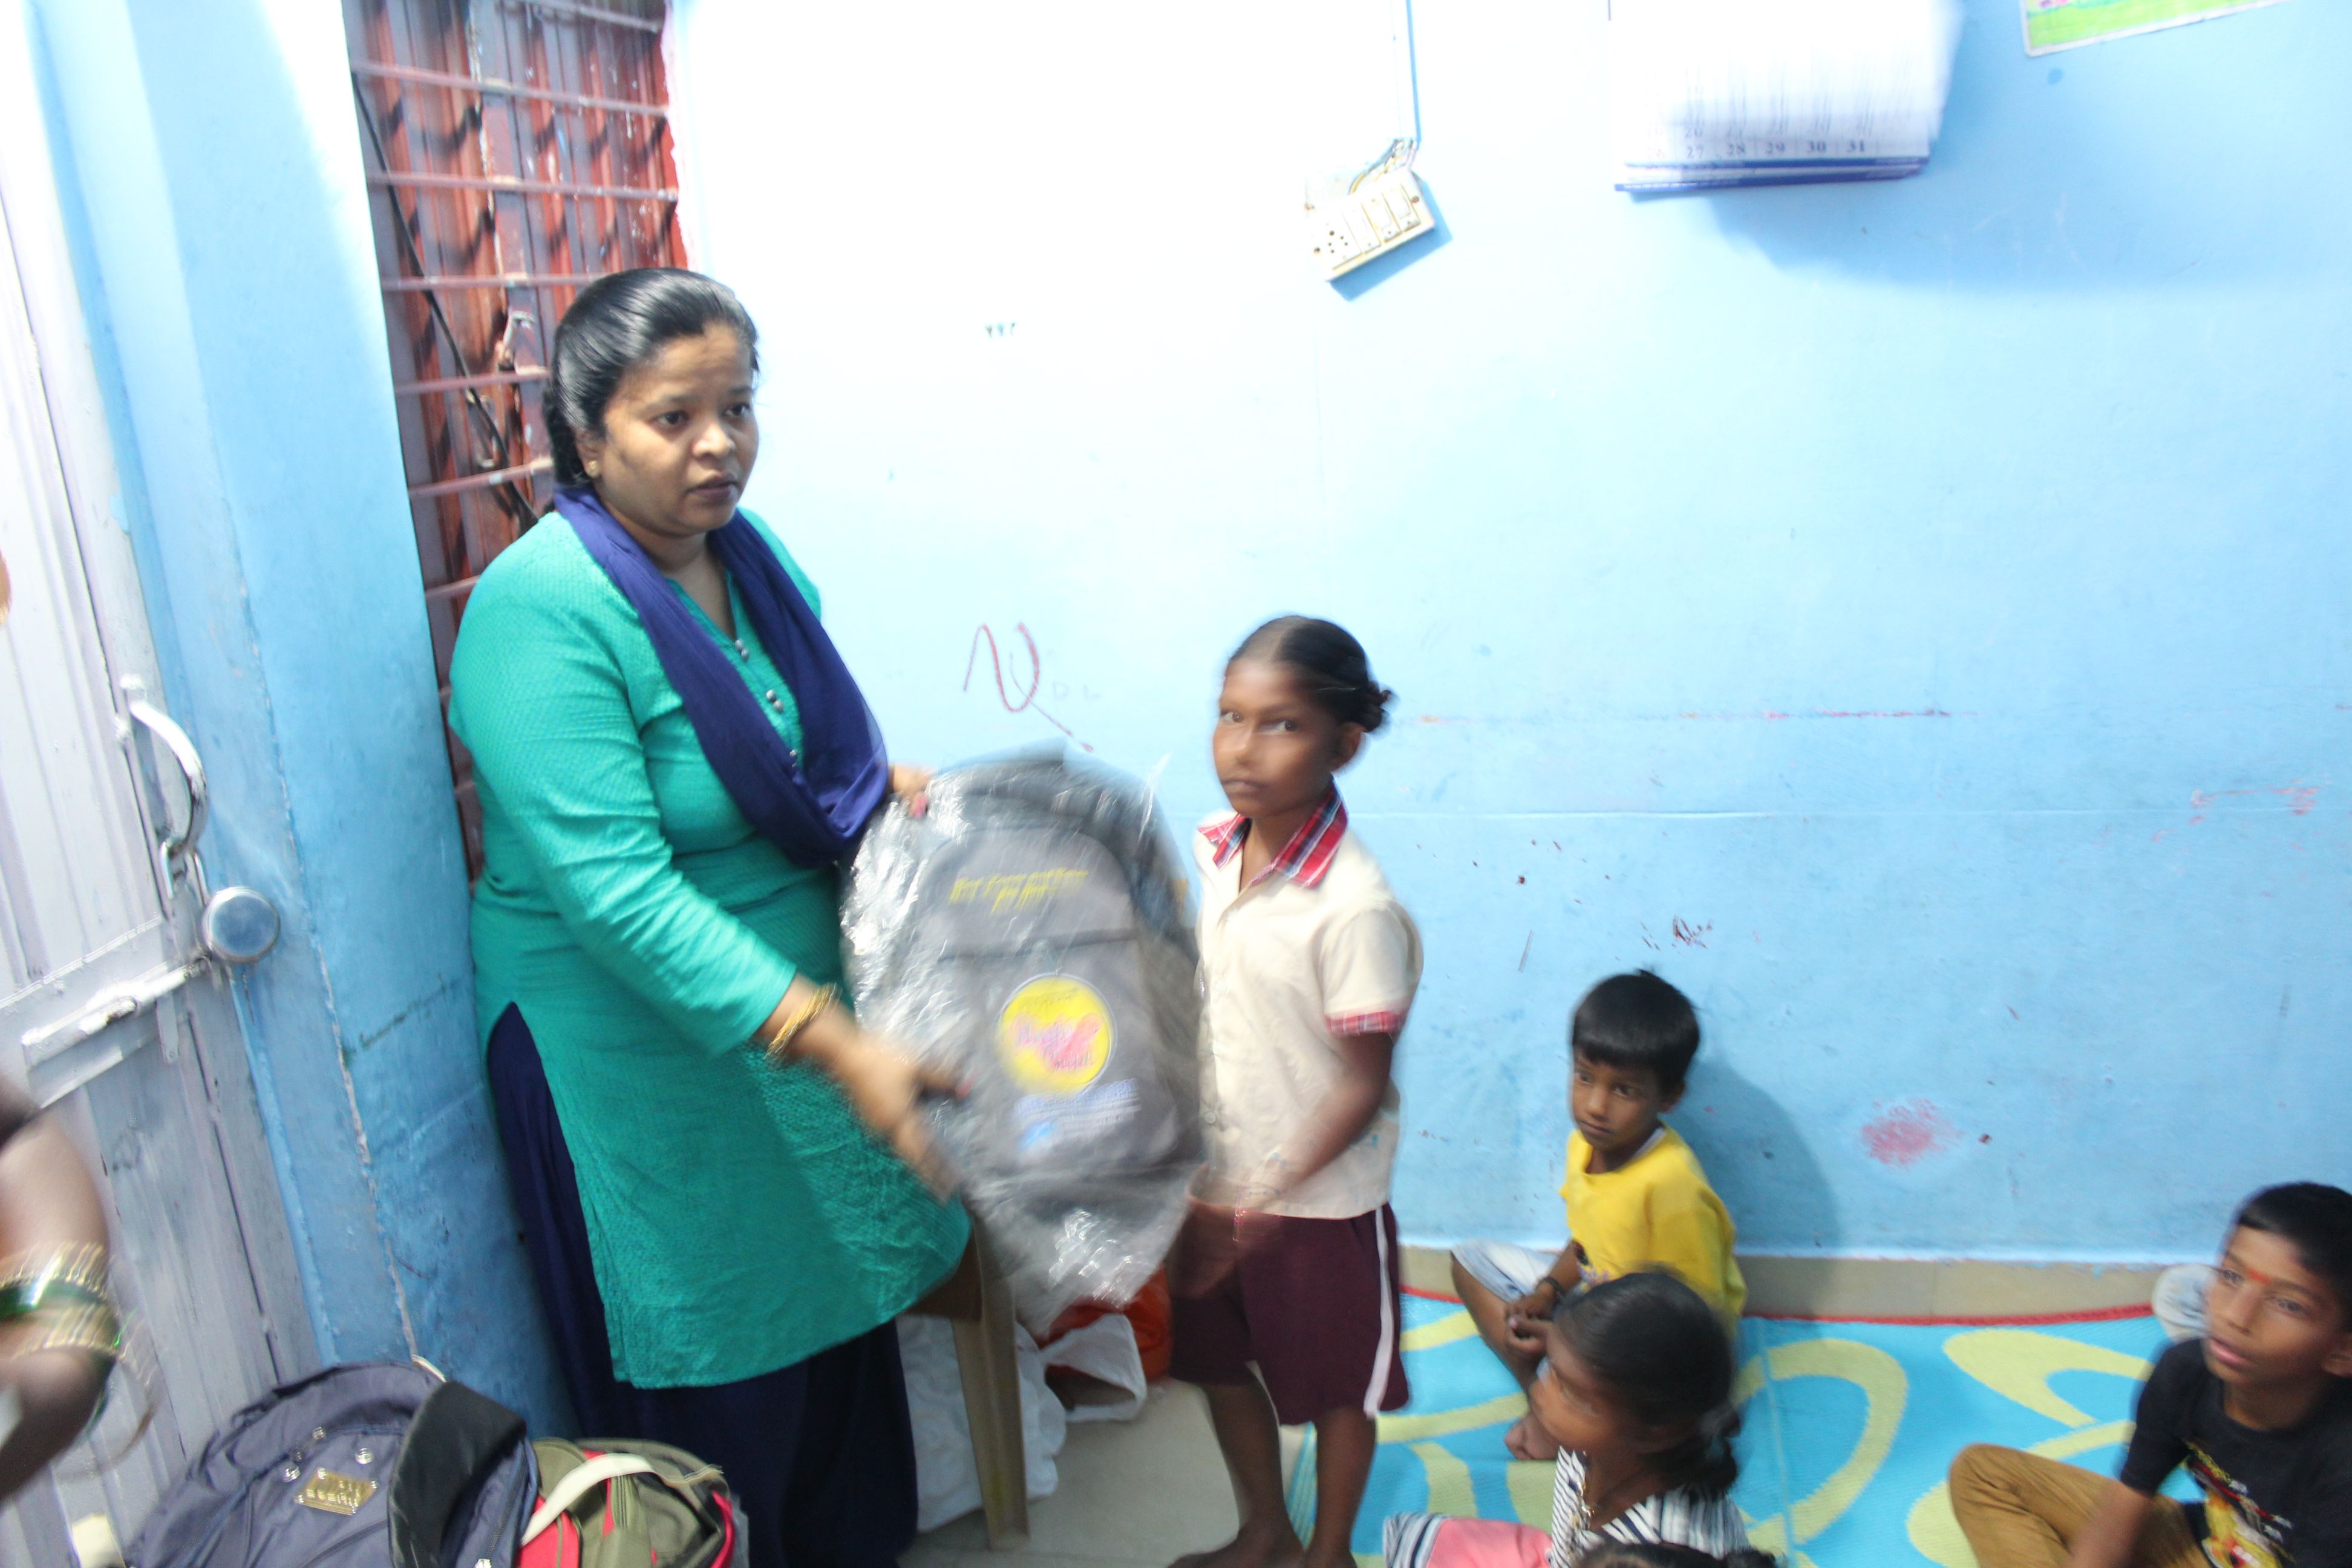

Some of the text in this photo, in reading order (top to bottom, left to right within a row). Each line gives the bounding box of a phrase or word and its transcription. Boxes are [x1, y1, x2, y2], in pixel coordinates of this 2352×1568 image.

[1686, 143, 1704, 158] 27
[1726, 142, 1746, 155] 28
[1765, 140, 1785, 154] 29
[1806, 140, 1826, 152] 30
[1847, 139, 1865, 152] 31
